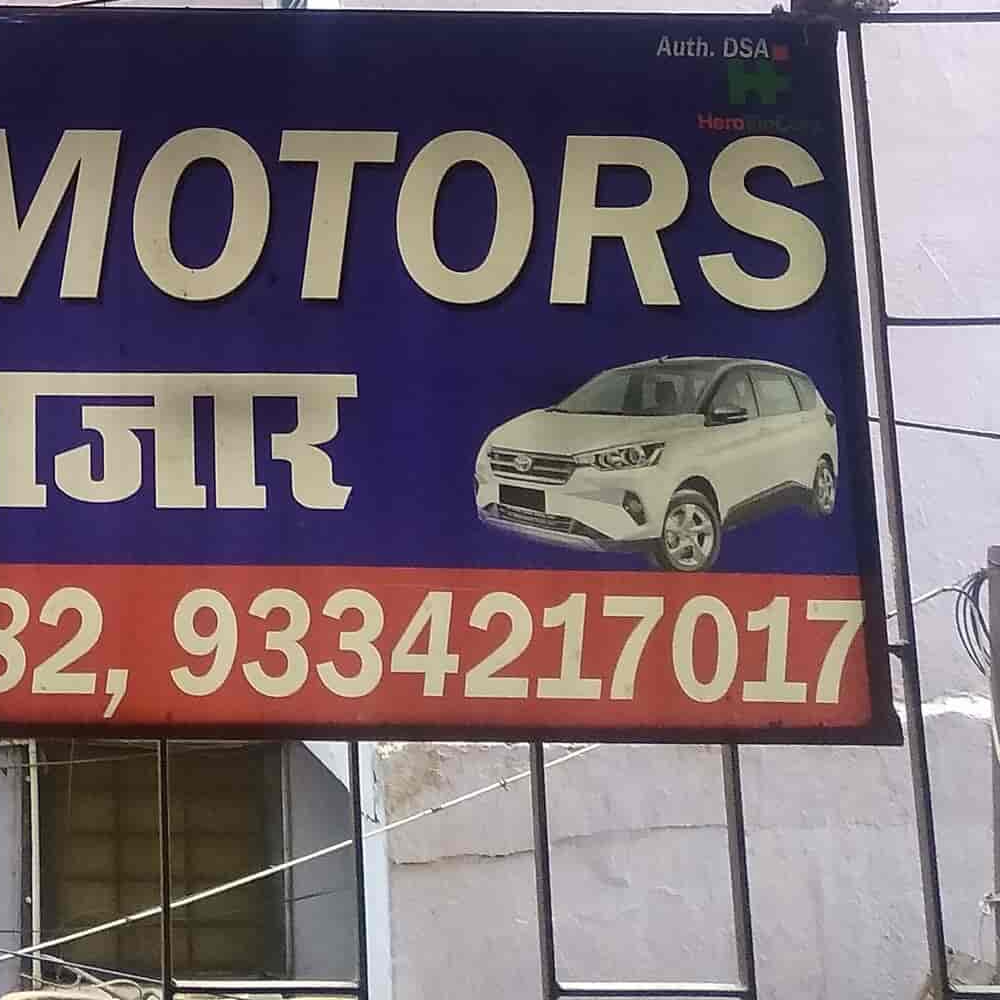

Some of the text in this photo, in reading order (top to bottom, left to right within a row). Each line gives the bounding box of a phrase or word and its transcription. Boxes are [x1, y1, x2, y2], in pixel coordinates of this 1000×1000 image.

[656, 36, 769, 58] Auth. DSA
[170, 588, 865, 704] 9334217017
